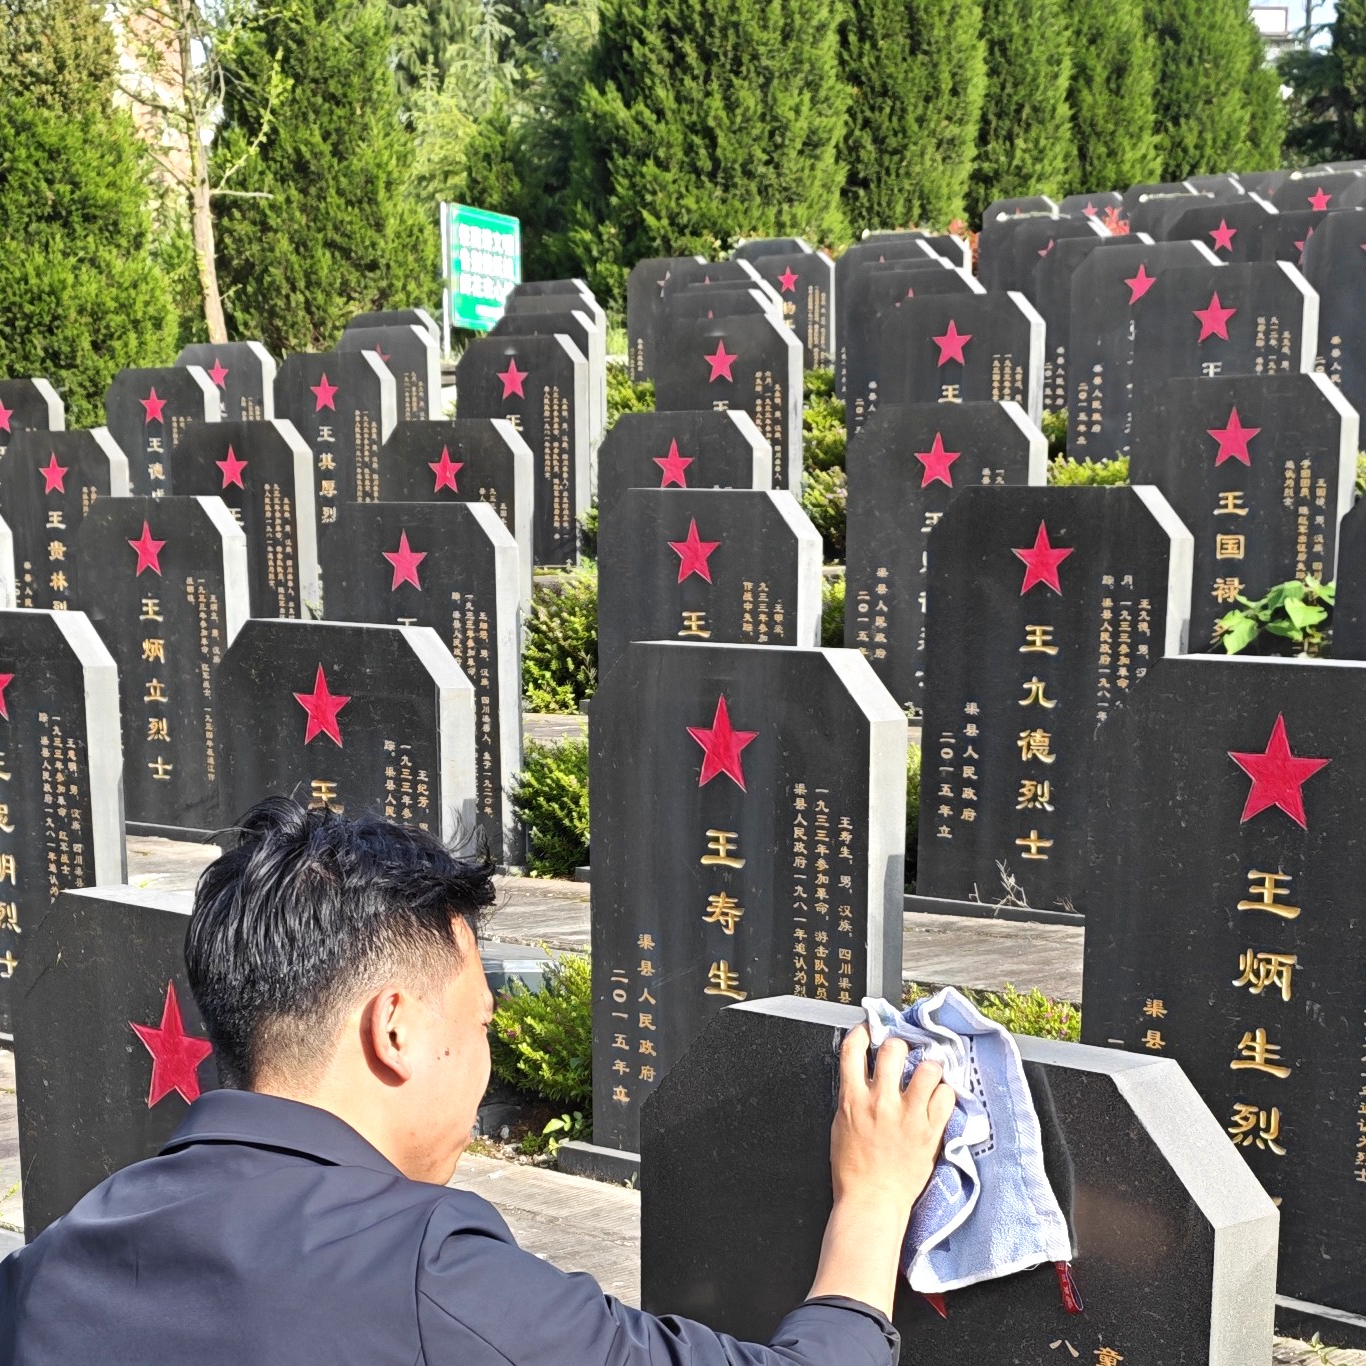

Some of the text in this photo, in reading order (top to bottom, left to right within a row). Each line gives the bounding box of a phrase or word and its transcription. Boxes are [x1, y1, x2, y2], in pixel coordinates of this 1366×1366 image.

[938, 384, 963, 403] 王
[139, 597, 173, 781] 王炳立烈士
[677, 611, 712, 638] 王
[960, 701, 980, 822] 渠县人民政府
[1015, 624, 1059, 860] 王九德烈士
[700, 828, 748, 1001] 王寿生
[637, 933, 657, 1083] 渠县人民政府
[1140, 997, 1168, 1051] 渠县
